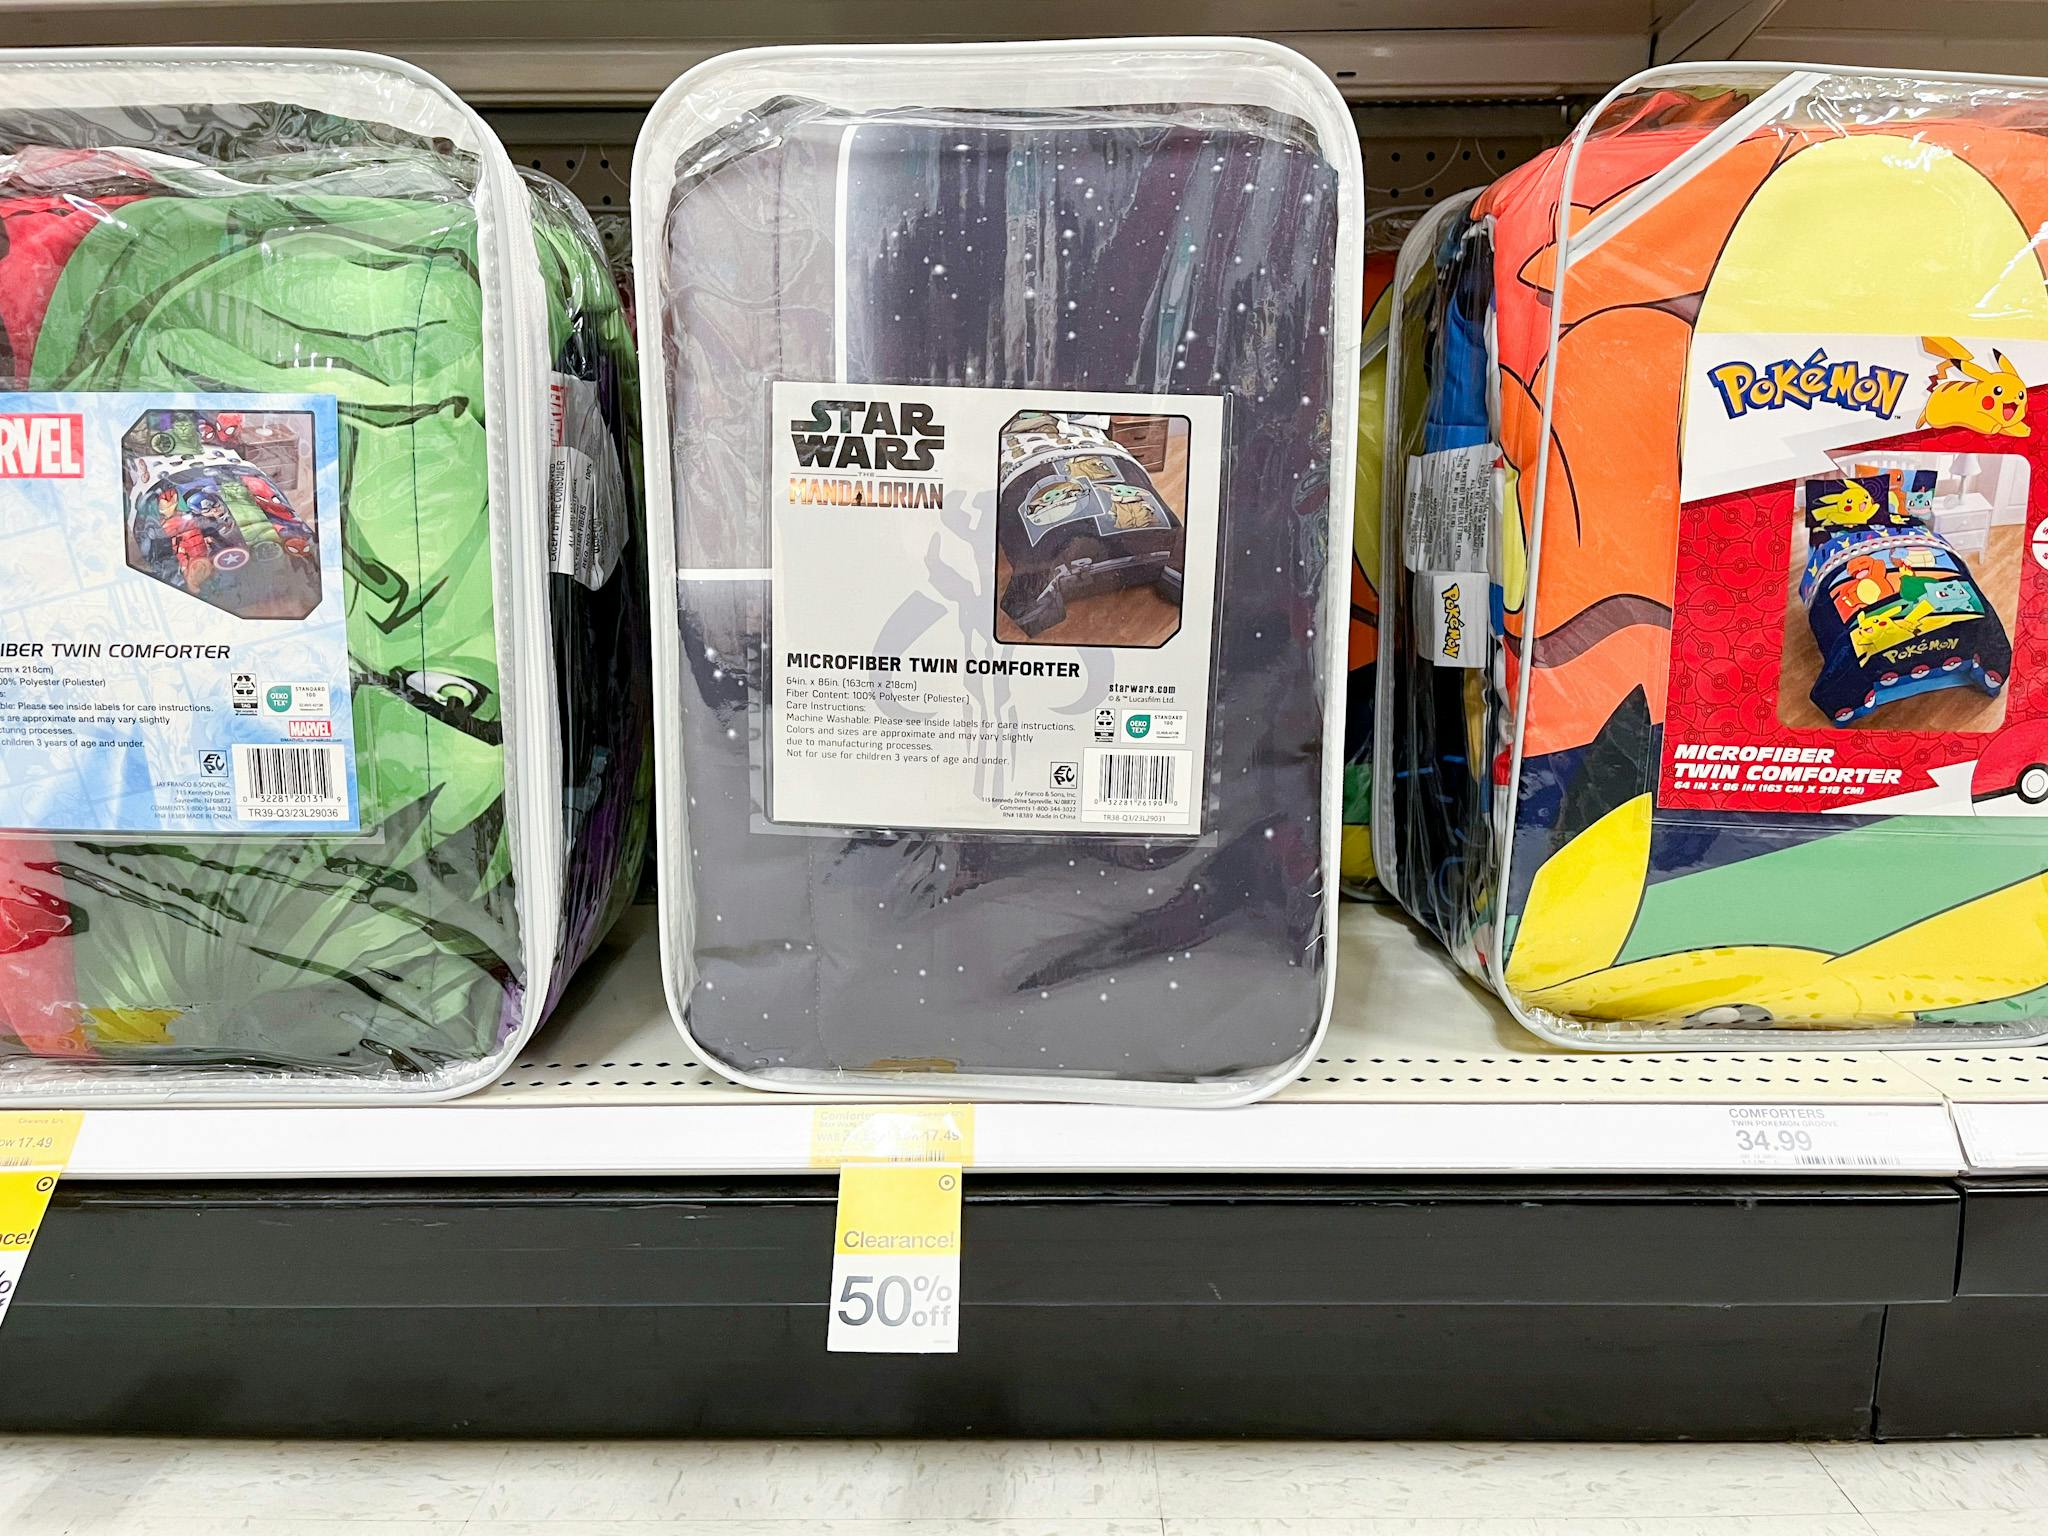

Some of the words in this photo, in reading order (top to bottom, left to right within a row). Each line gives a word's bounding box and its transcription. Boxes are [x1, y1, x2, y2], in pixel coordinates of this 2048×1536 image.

[791, 400, 945, 436] STAR
[791, 434, 945, 471] WARS
[555, 460, 565, 501] CONSUMER
[789, 478, 943, 510] MANDALORIAN
[0, 643, 44, 657] IBER
[52, 643, 101, 658] TWIN
[109, 643, 231, 659] COMFORTER
[22, 666, 54, 675] 218cm)
[787, 653, 901, 671] MICROFIBER
[909, 657, 957, 673] TWIN
[966, 660, 1080, 677] COMFORTER
[20, 678, 60, 688] Polyester
[62, 678, 106, 688] (Poliester)
[786, 677, 807, 685] 64in.
[818, 678, 840, 686] 86in.
[842, 679, 875, 688] (163cm
[885, 680, 917, 691] 218cm)
[1109, 683, 1176, 694] starwars.com
[786, 689, 808, 698] Fiber
[812, 690, 849, 699] Content:
[853, 691, 876, 700] 100%
[879, 692, 920, 702] Polyester
[923, 693, 970, 705] (Poliester)
[18, 702, 47, 710] Please
[66, 703, 92, 711] inside
[94, 703, 120, 711] labels
[159, 703, 214, 712] instructions.
[786, 701, 808, 710] Care
[811, 702, 867, 712] Instructions:
[22, 715, 76, 725] approximate
[78, 715, 95, 723] and
[97, 717, 116, 725] may
[118, 717, 136, 725] vary
[139, 716, 170, 725] slightly
[786, 713, 823, 722] Machine
[874, 716, 903, 726] Please
[906, 718, 921, 726] see
[924, 719, 950, 727] inside
[953, 719, 978, 728] labels
[981, 720, 994, 729] for
[1020, 723, 1076, 732] instructions.
[29, 728, 74, 736] processes.
[289, 721, 331, 737] MARVEL
[786, 725, 815, 735] Colors
[818, 726, 834, 735] and
[837, 727, 859, 736] sizes
[862, 729, 878, 737] are
[880, 729, 936, 739] approximate
[938, 731, 955, 739] and
[958, 733, 976, 741] may
[980, 733, 999, 742] vary
[1001, 733, 1034, 743] slightly
[1, 738, 34, 746] children
[44, 740, 68, 748] years
[80, 740, 96, 749] age
[99, 739, 116, 747] and
[786, 737, 803, 745] due
[806, 738, 815, 746] to
[818, 739, 883, 750] manufacturing
[886, 742, 933, 751] processes.
[786, 749, 801, 758] Not
[805, 750, 818, 758] for
[840, 751, 853, 760] for
[856, 751, 892, 761] children
[895, 753, 900, 761] 3
[903, 755, 928, 763] years
[931, 755, 940, 763] of
[943, 757, 959, 765] age
[962, 755, 979, 764] and
[981, 756, 1010, 765] under.
[1674, 744, 1835, 764] MICROFIBER
[1674, 763, 1740, 779] TWIN
[1746, 765, 1902, 785] COMFORTER
[1674, 782, 1691, 790] 64
[1693, 782, 1707, 790] IN
[1722, 783, 1738, 791] 86
[1741, 784, 1756, 792] IN
[1758, 783, 1782, 794] (163
[1785, 784, 1803, 793] CM
[1806, 785, 1816, 793] X
[1819, 786, 1839, 794] 218
[1842, 786, 1864, 795] CM)
[260, 795, 289, 803] 32281
[294, 795, 324, 803] 20131
[1729, 1108, 1825, 1119] COMFORTERS
[18, 1137, 53, 1148] 17.49
[1736, 1130, 1812, 1151] 34.99
[844, 1230, 954, 1248] Clearance!
[912, 1305, 951, 1327] off
